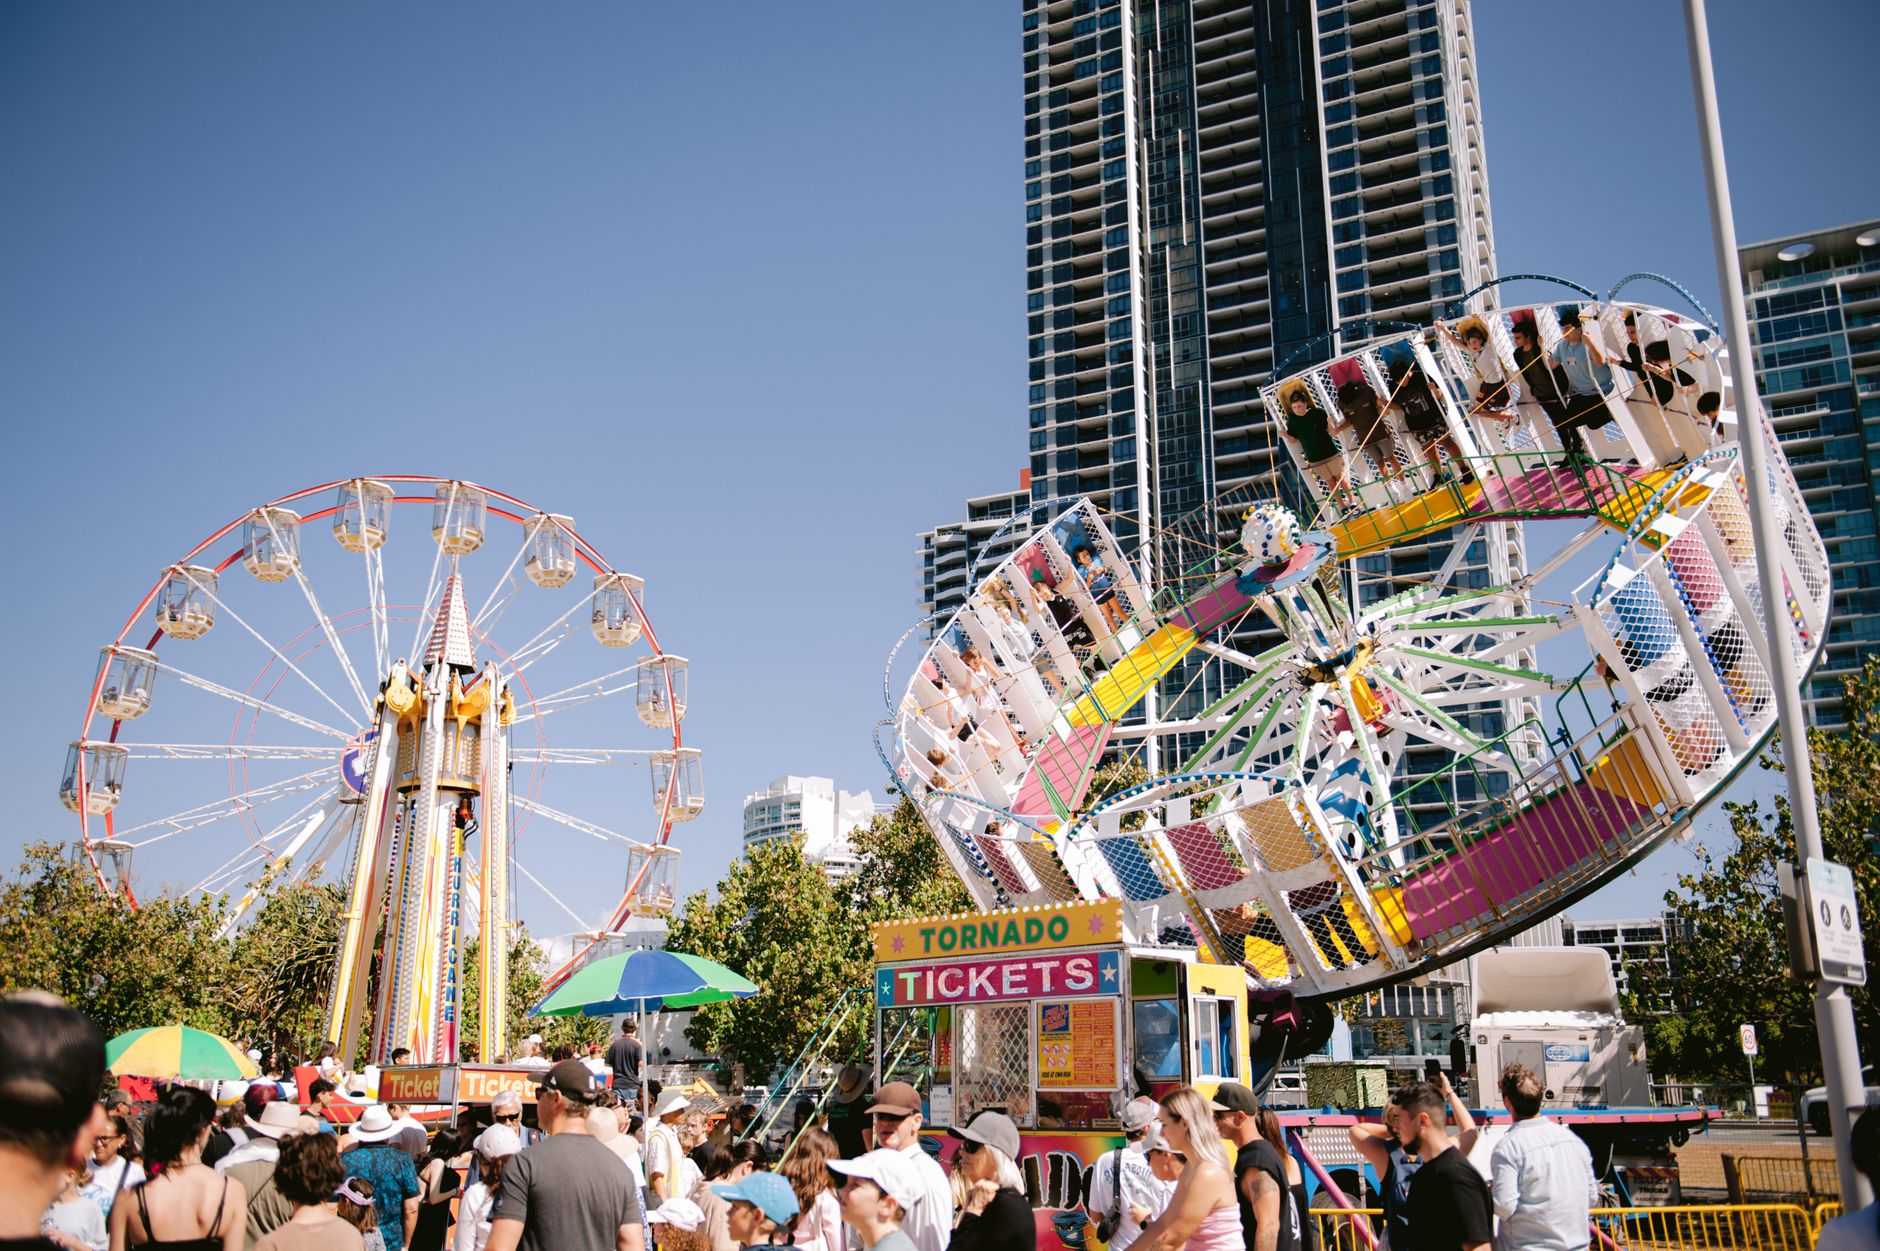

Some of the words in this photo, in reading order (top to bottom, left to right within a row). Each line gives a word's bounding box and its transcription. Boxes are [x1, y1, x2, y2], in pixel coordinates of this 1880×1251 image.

[444, 857, 462, 1022] HURRICANE
[919, 915, 1070, 953] TORNADO
[898, 957, 1094, 1000] TICKETS
[1639, 1186, 1669, 1194] TRUCKS
